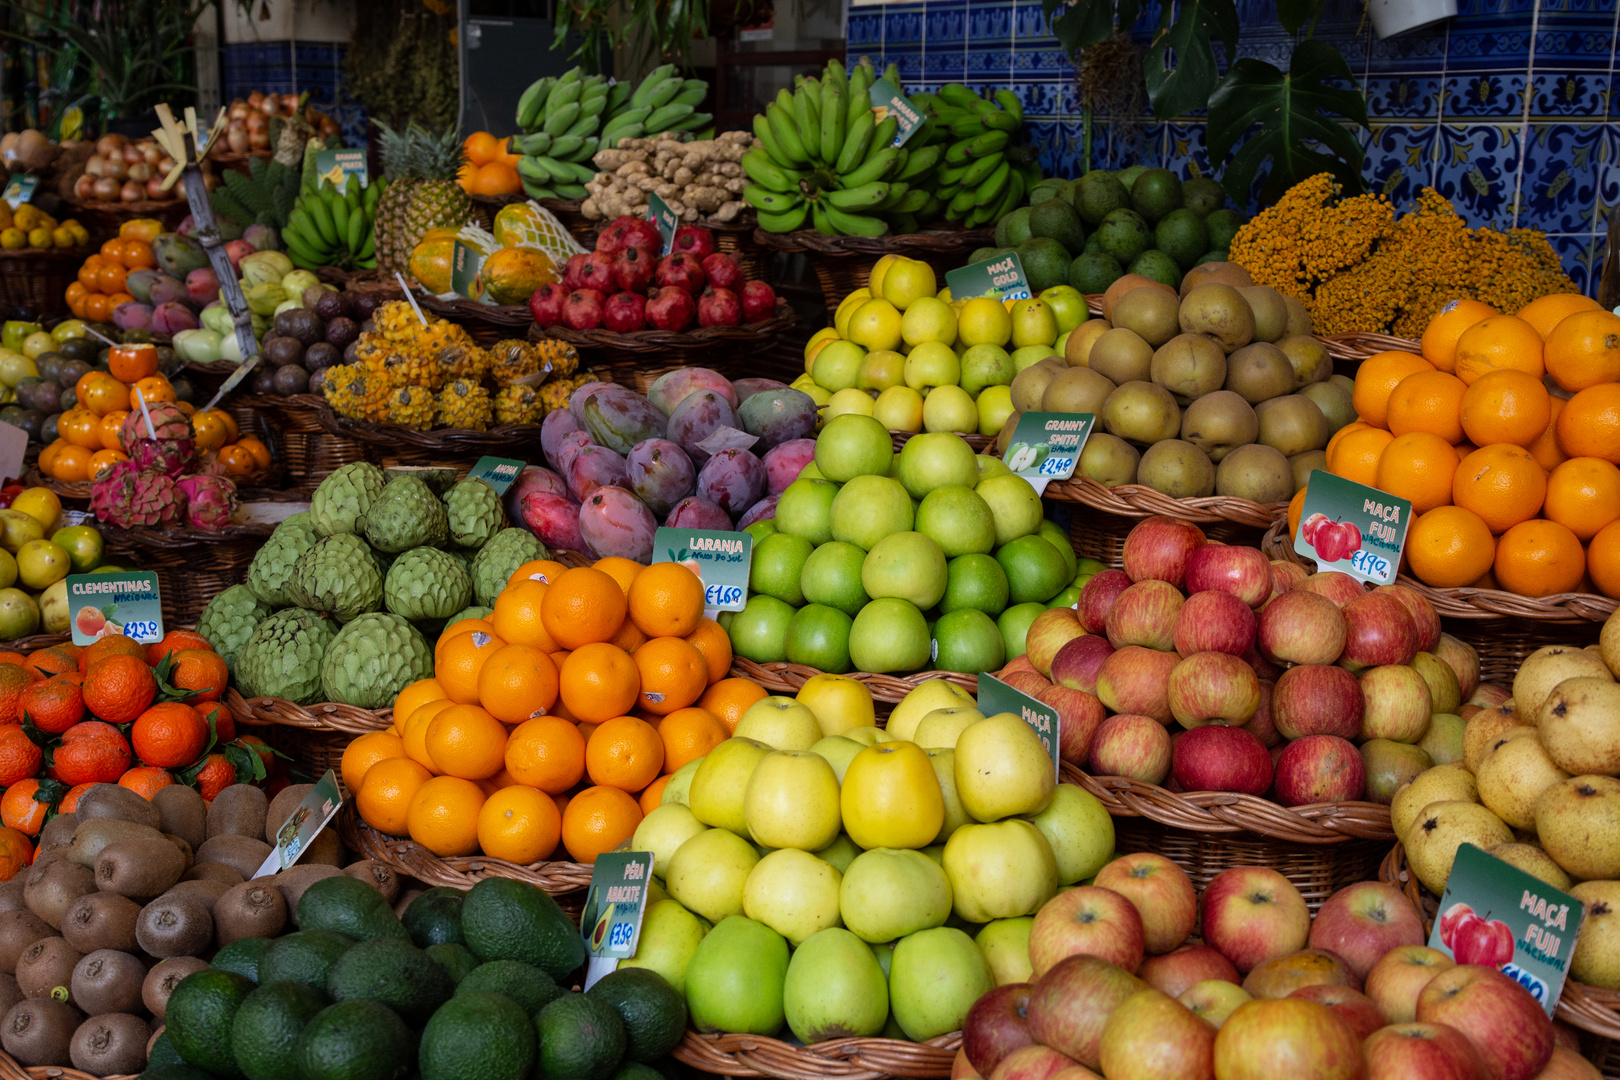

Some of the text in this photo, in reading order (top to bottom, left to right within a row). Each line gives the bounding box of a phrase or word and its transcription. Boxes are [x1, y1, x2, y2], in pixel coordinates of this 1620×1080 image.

[986, 257, 1015, 275] MAÇÃ
[993, 271, 1018, 286] GOLD
[1044, 420, 1086, 431] GRANNY
[1048, 434, 1080, 445] SMITH
[493, 464, 519, 475] ANONA
[1038, 457, 1072, 475] €2.40
[1363, 498, 1400, 524] MAÇÃ
[1369, 521, 1397, 543] FUJI
[689, 537, 743, 555] LARANJA
[714, 553, 726, 562] DO
[1351, 551, 1387, 575] €1.90
[72, 580, 151, 595] CLEMENTINAS
[705, 585, 743, 605] €1.60
[1022, 705, 1051, 734] MAÇÃ
[623, 860, 644, 880] PÊRA
[606, 886, 641, 902] ABACATE
[1519, 889, 1569, 932] MAÇÃ
[609, 922, 633, 947] €3.50
[1525, 923, 1561, 957] FUJI
